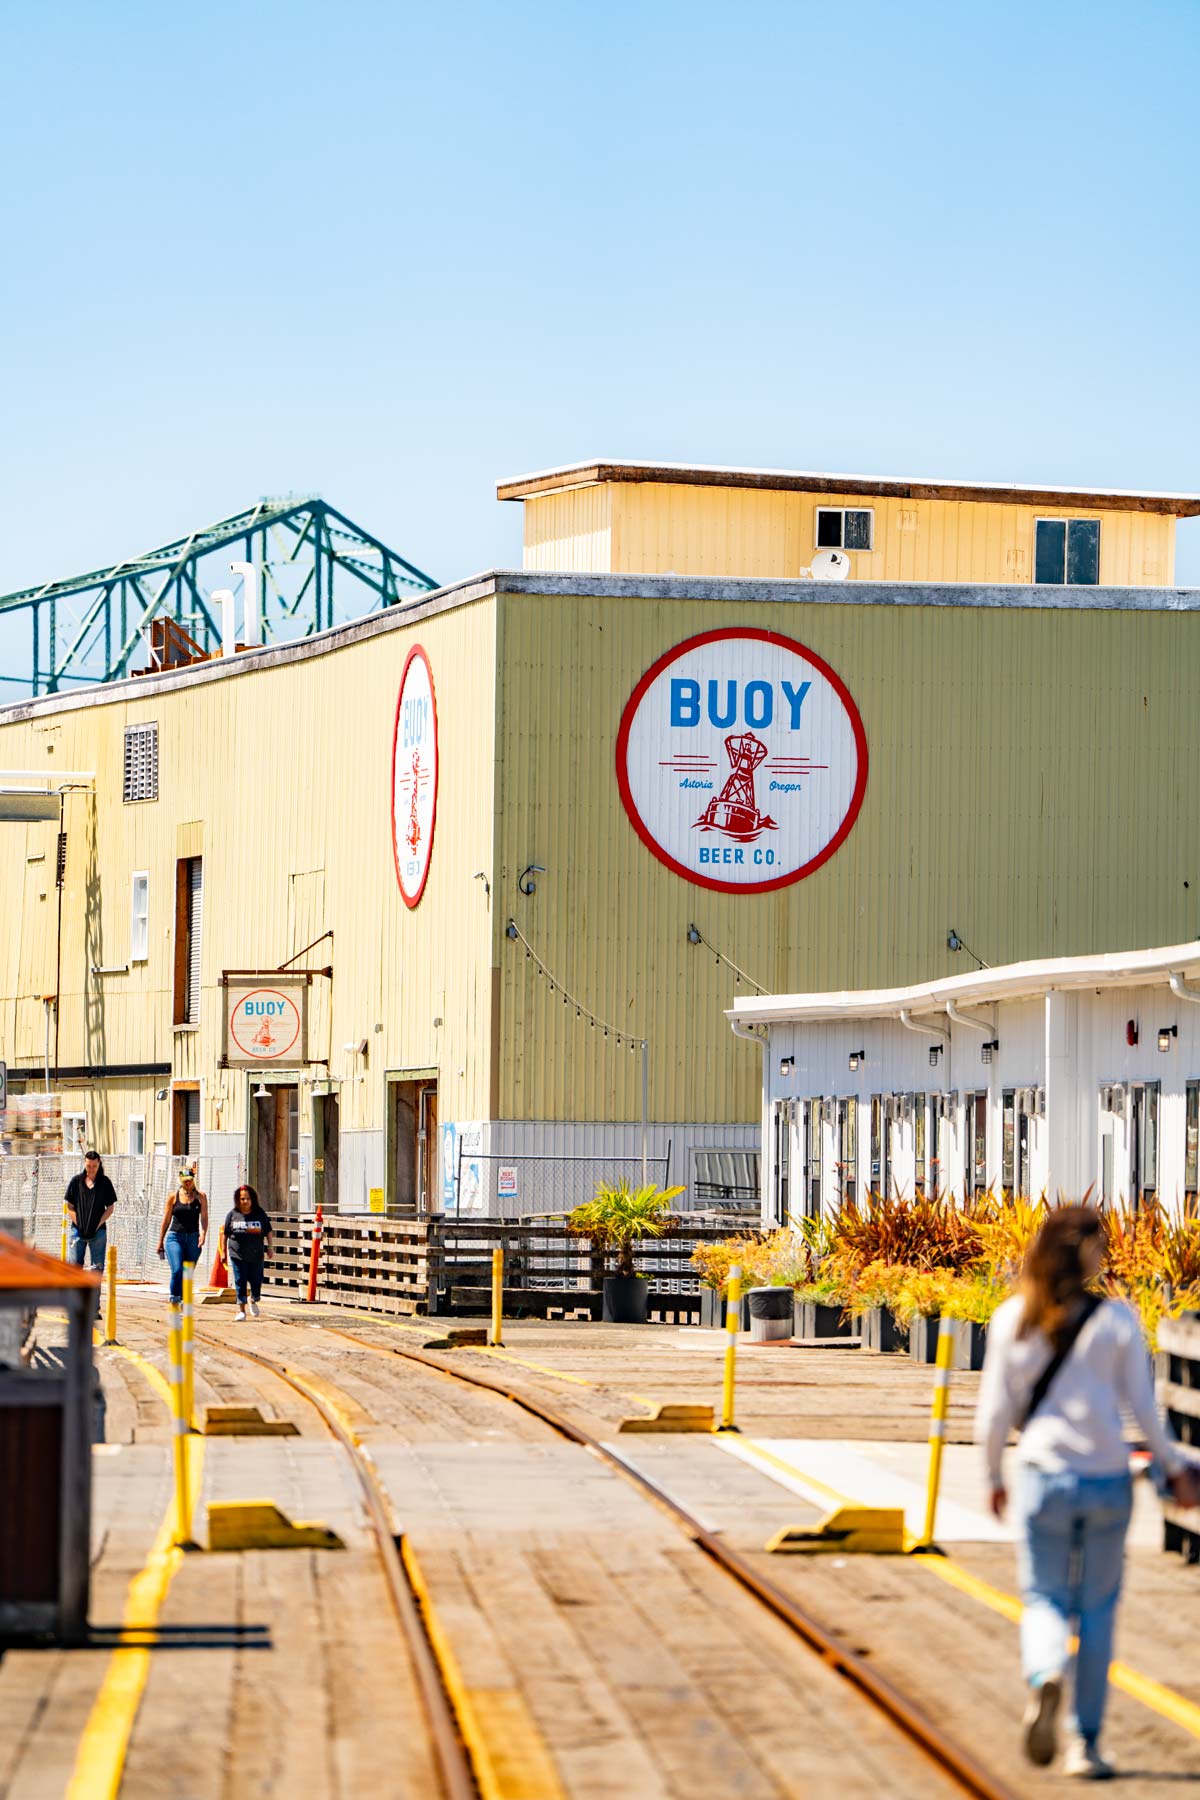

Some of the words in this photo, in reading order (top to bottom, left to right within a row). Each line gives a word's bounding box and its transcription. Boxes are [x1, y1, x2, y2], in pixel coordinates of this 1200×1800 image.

[670, 678, 812, 730] BUOY
[403, 695, 429, 748] BUOY
[679, 778, 713, 789] Astoria
[769, 780, 802, 793] Oregon
[699, 847, 745, 864] BEER
[753, 849, 781, 865] CO.
[245, 1001, 285, 1016] BUOY
